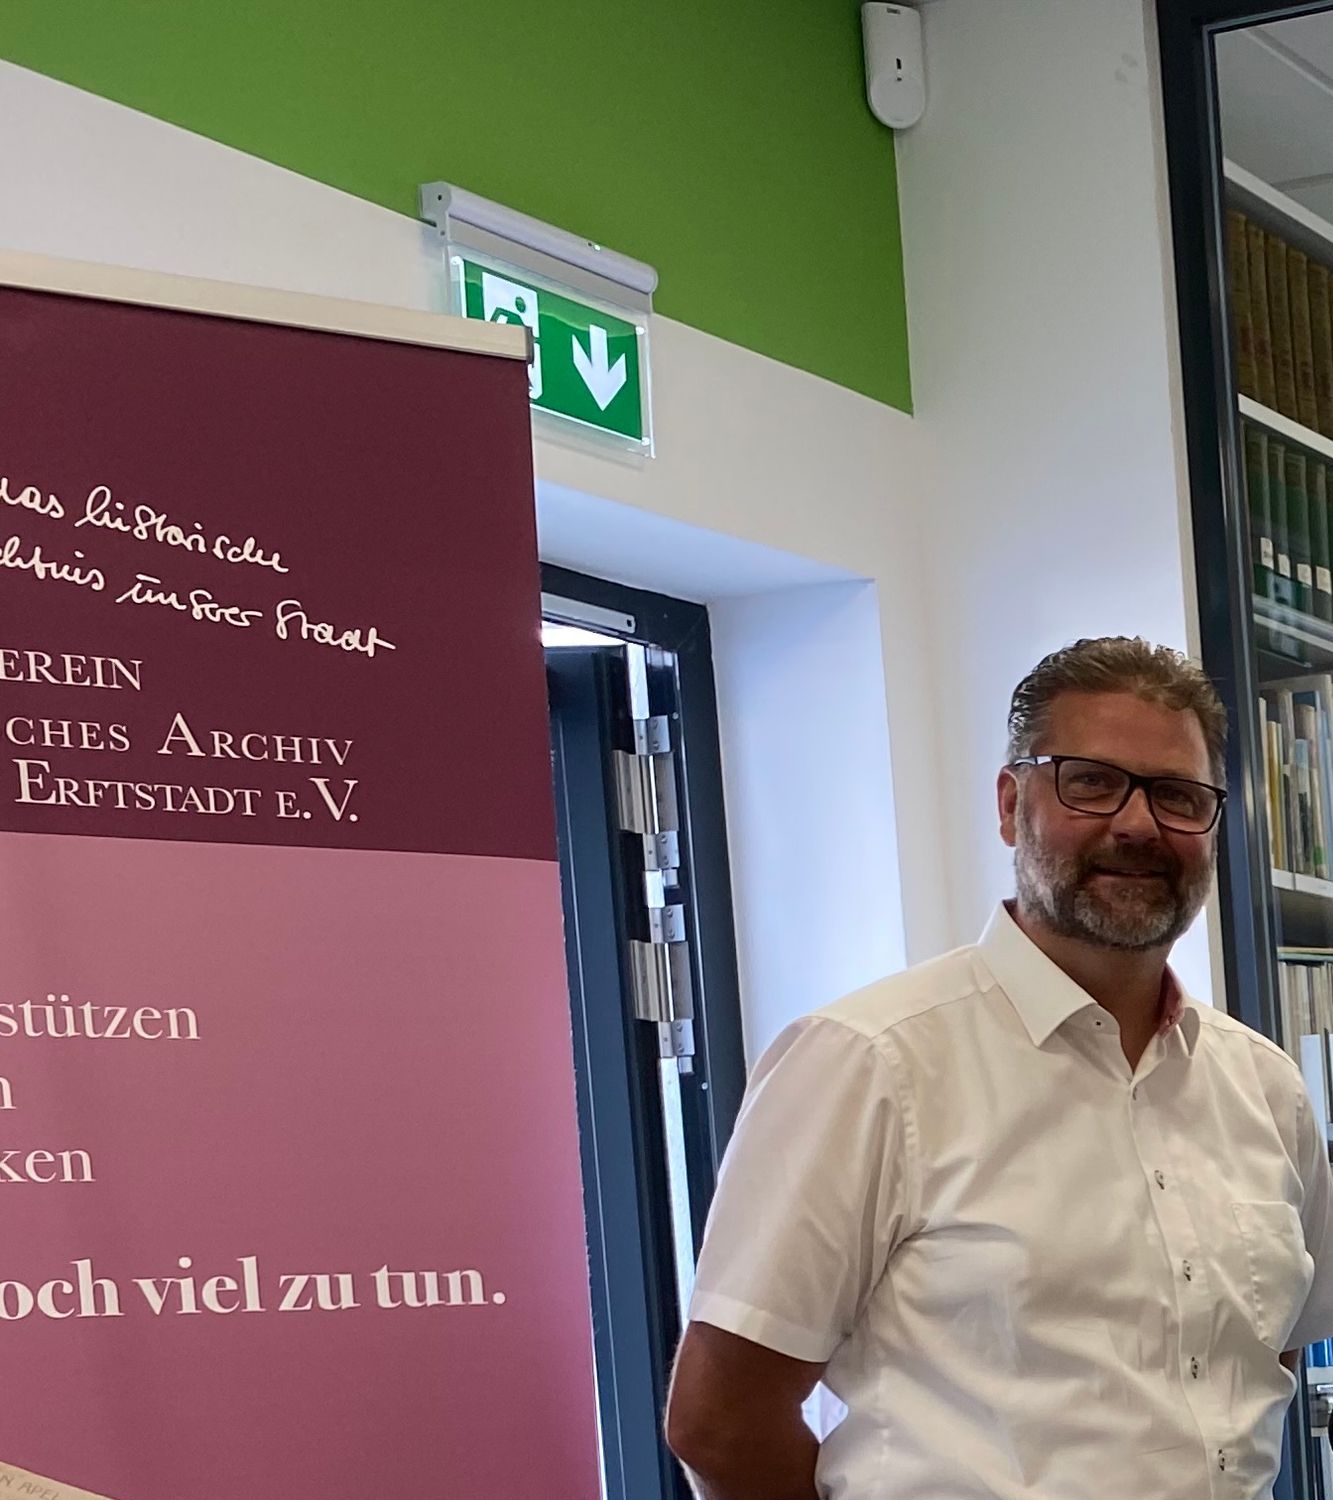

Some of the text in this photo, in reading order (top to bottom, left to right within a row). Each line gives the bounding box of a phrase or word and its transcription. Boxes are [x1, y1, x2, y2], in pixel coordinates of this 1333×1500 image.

[74, 485, 289, 573] historische
[275, 599, 396, 657] Stadt
[5, 716, 131, 752] CHES
[132, 1255, 266, 1316] viel
[278, 1273, 361, 1313] zu
[369, 1263, 507, 1308] tun.
